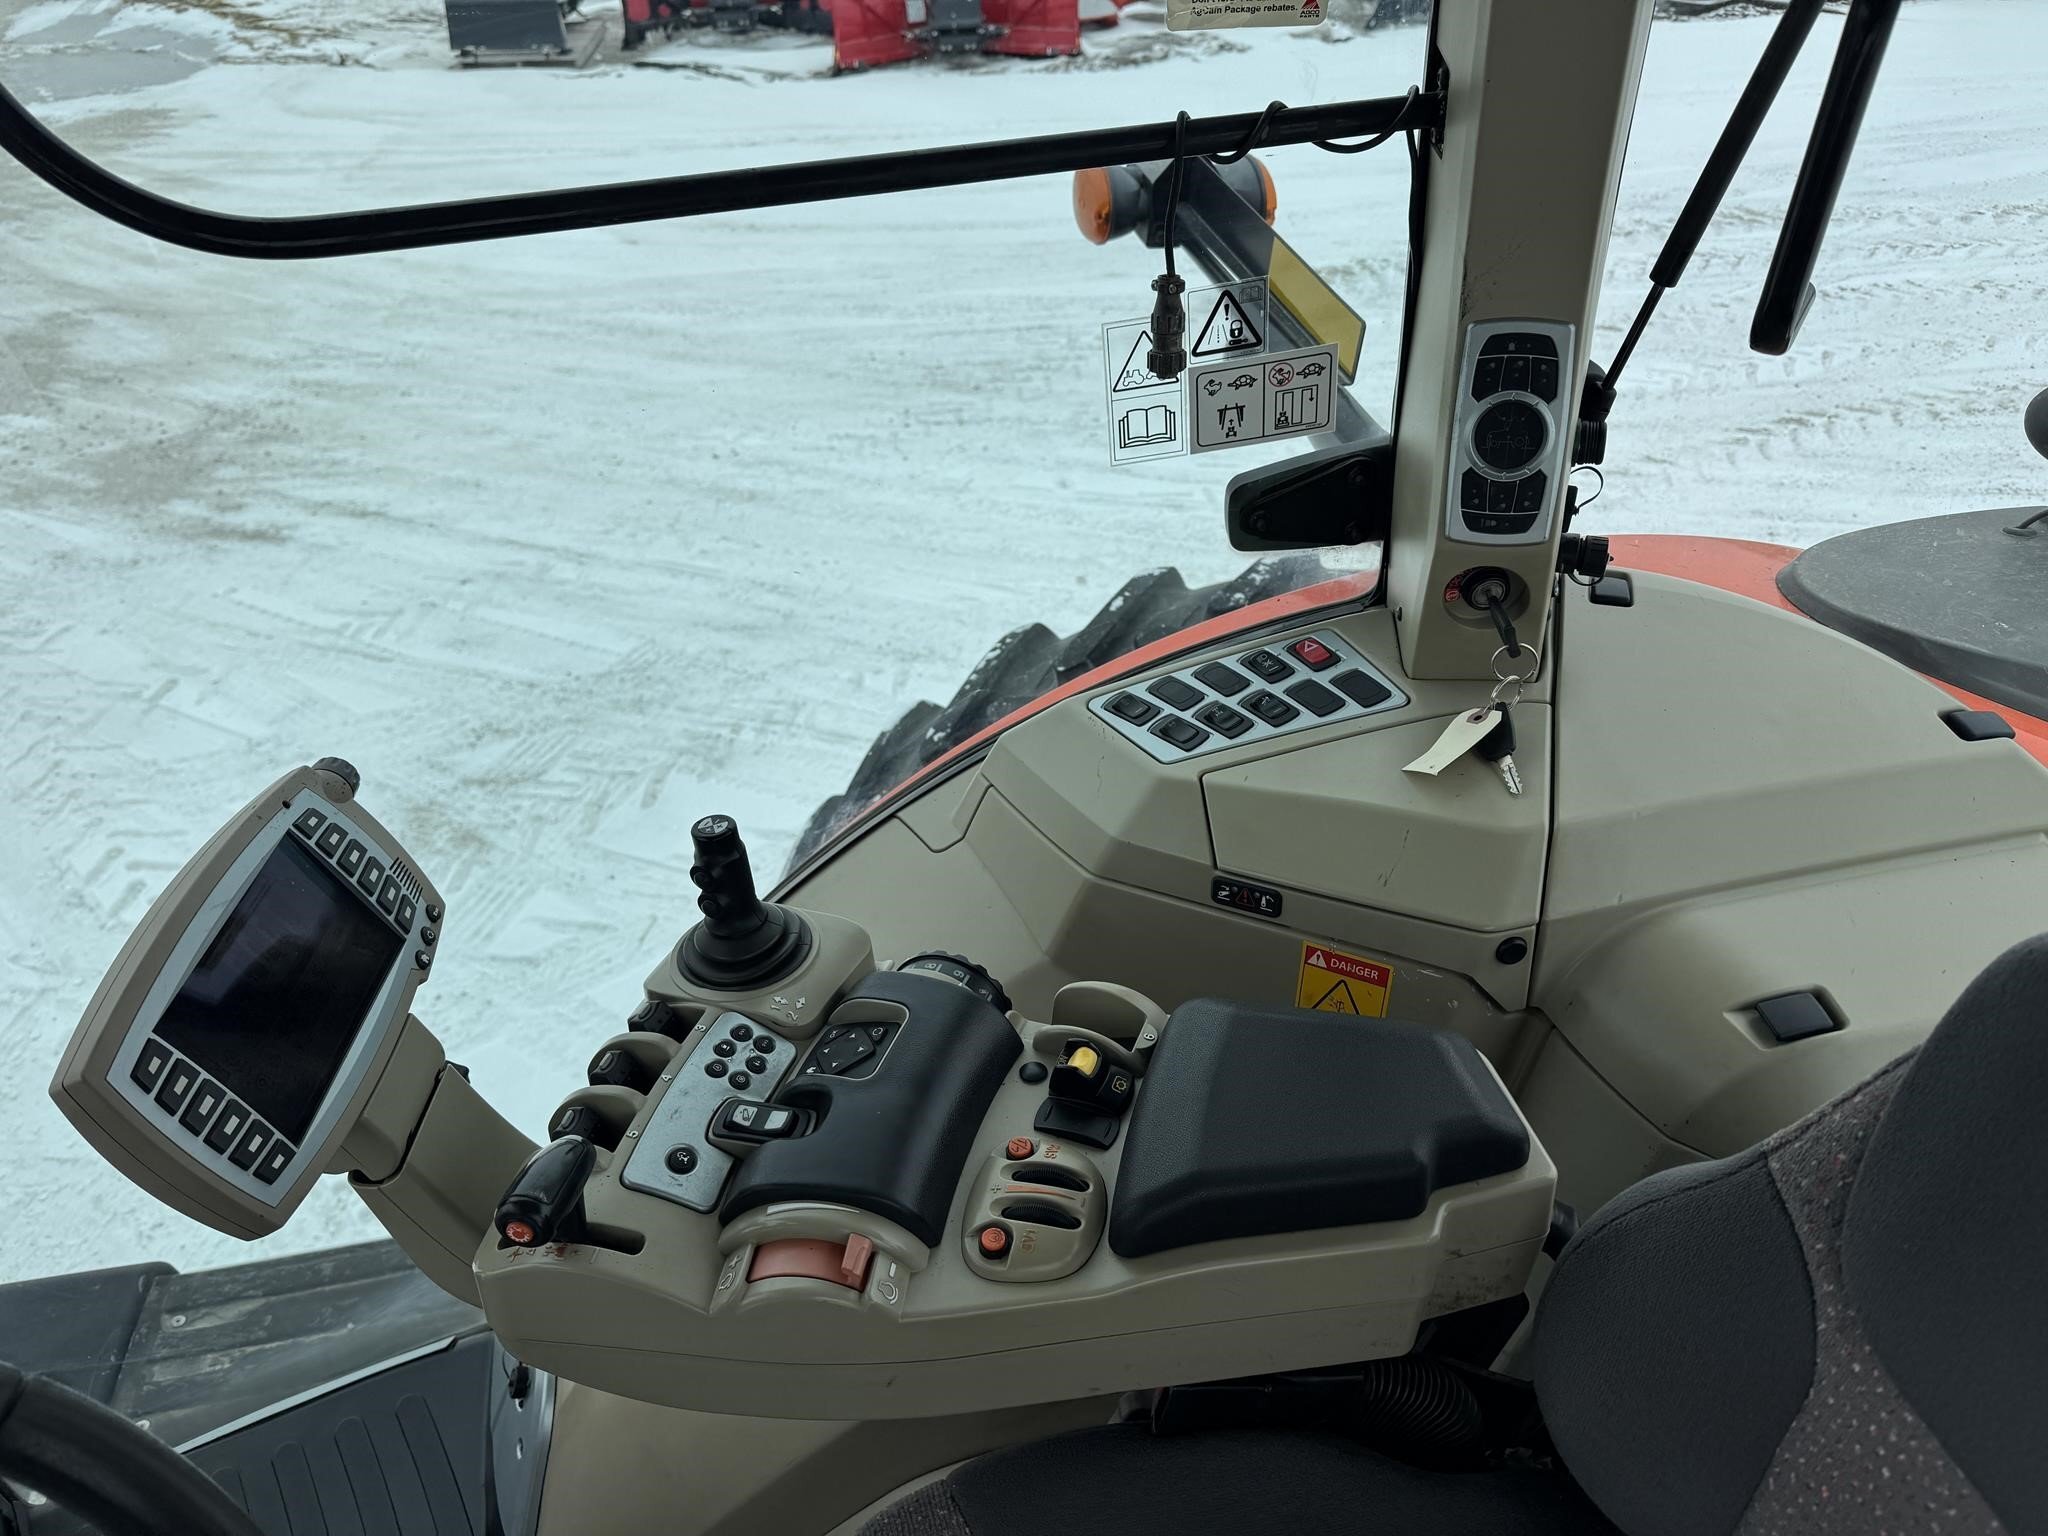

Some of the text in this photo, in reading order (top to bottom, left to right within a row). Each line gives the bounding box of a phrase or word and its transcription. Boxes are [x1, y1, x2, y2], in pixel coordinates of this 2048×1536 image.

[1225, 5, 1261, 15] Package
[1263, 4, 1298, 12] rebates.
[1330, 958, 1379, 980] DANGER
[786, 1010, 799, 1021] 2
[694, 1024, 706, 1032] 3
[661, 1073, 672, 1082] 4
[626, 1129, 639, 1139] 5
